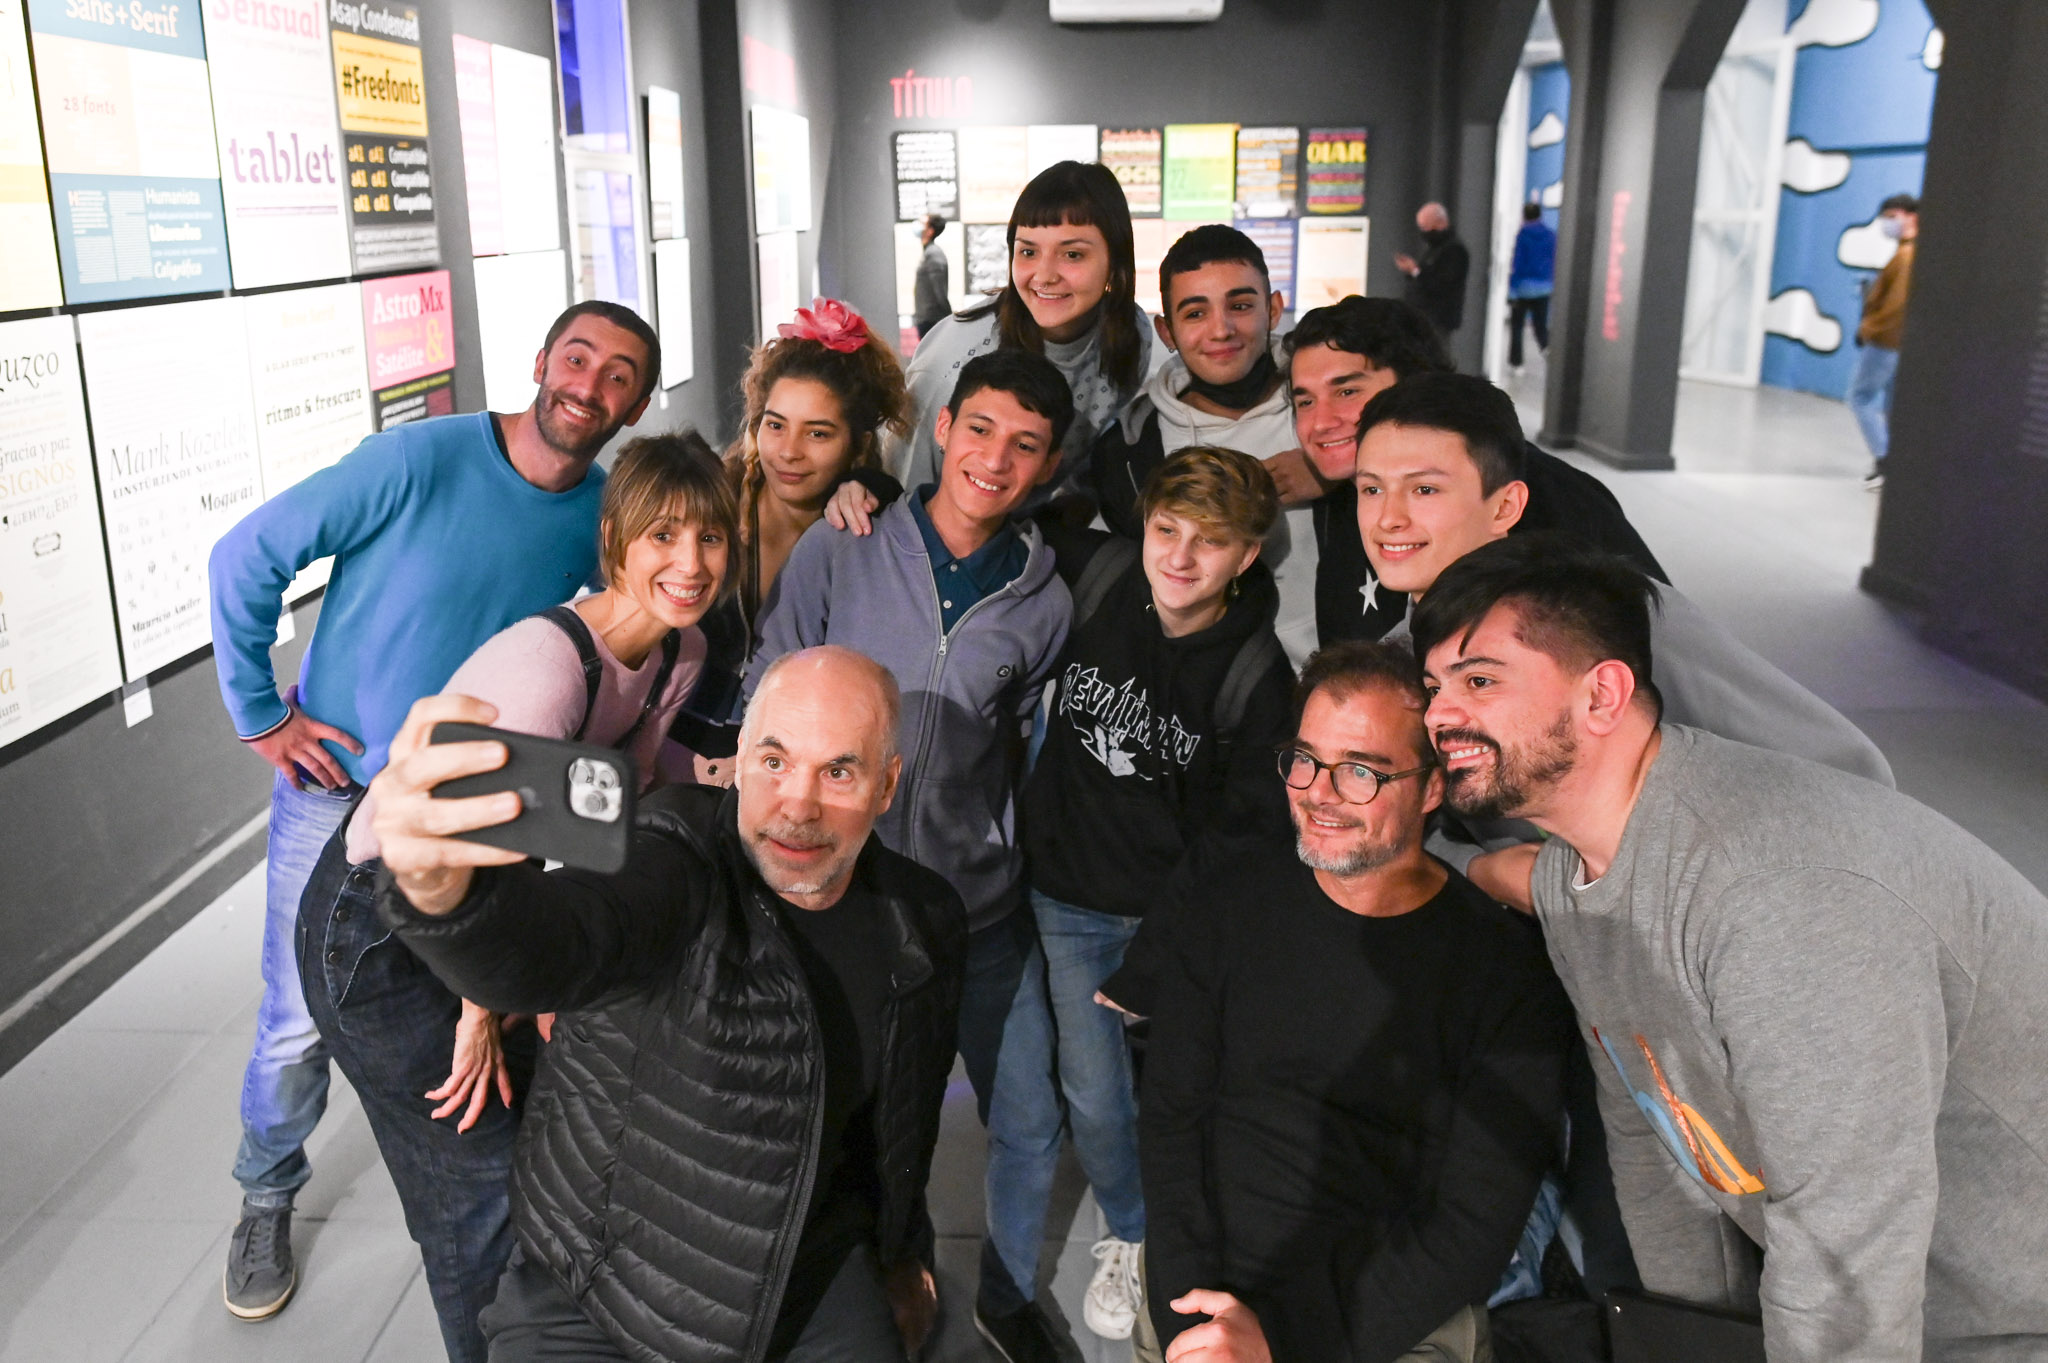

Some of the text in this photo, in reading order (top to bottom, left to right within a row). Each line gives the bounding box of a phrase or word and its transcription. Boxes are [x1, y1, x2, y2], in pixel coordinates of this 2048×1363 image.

[212, 0, 321, 40] Sensual
[330, 0, 420, 41] Asap Condensed
[342, 64, 421, 105] #Freefonts
[890, 69, 974, 119] TÍTULO
[62, 96, 117, 116] 28 fonts
[228, 130, 336, 184] tablet
[426, 318, 445, 364] &
[0, 351, 60, 391] uzco
[303, 398, 312, 415] &
[315, 386, 362, 413] frescura
[40, 443, 49, 462] y
[50, 436, 72, 460] paz
[110, 430, 170, 482] Mark
[199, 476, 254, 513] Mogwai
[131, 609, 172, 634] Mauricio
